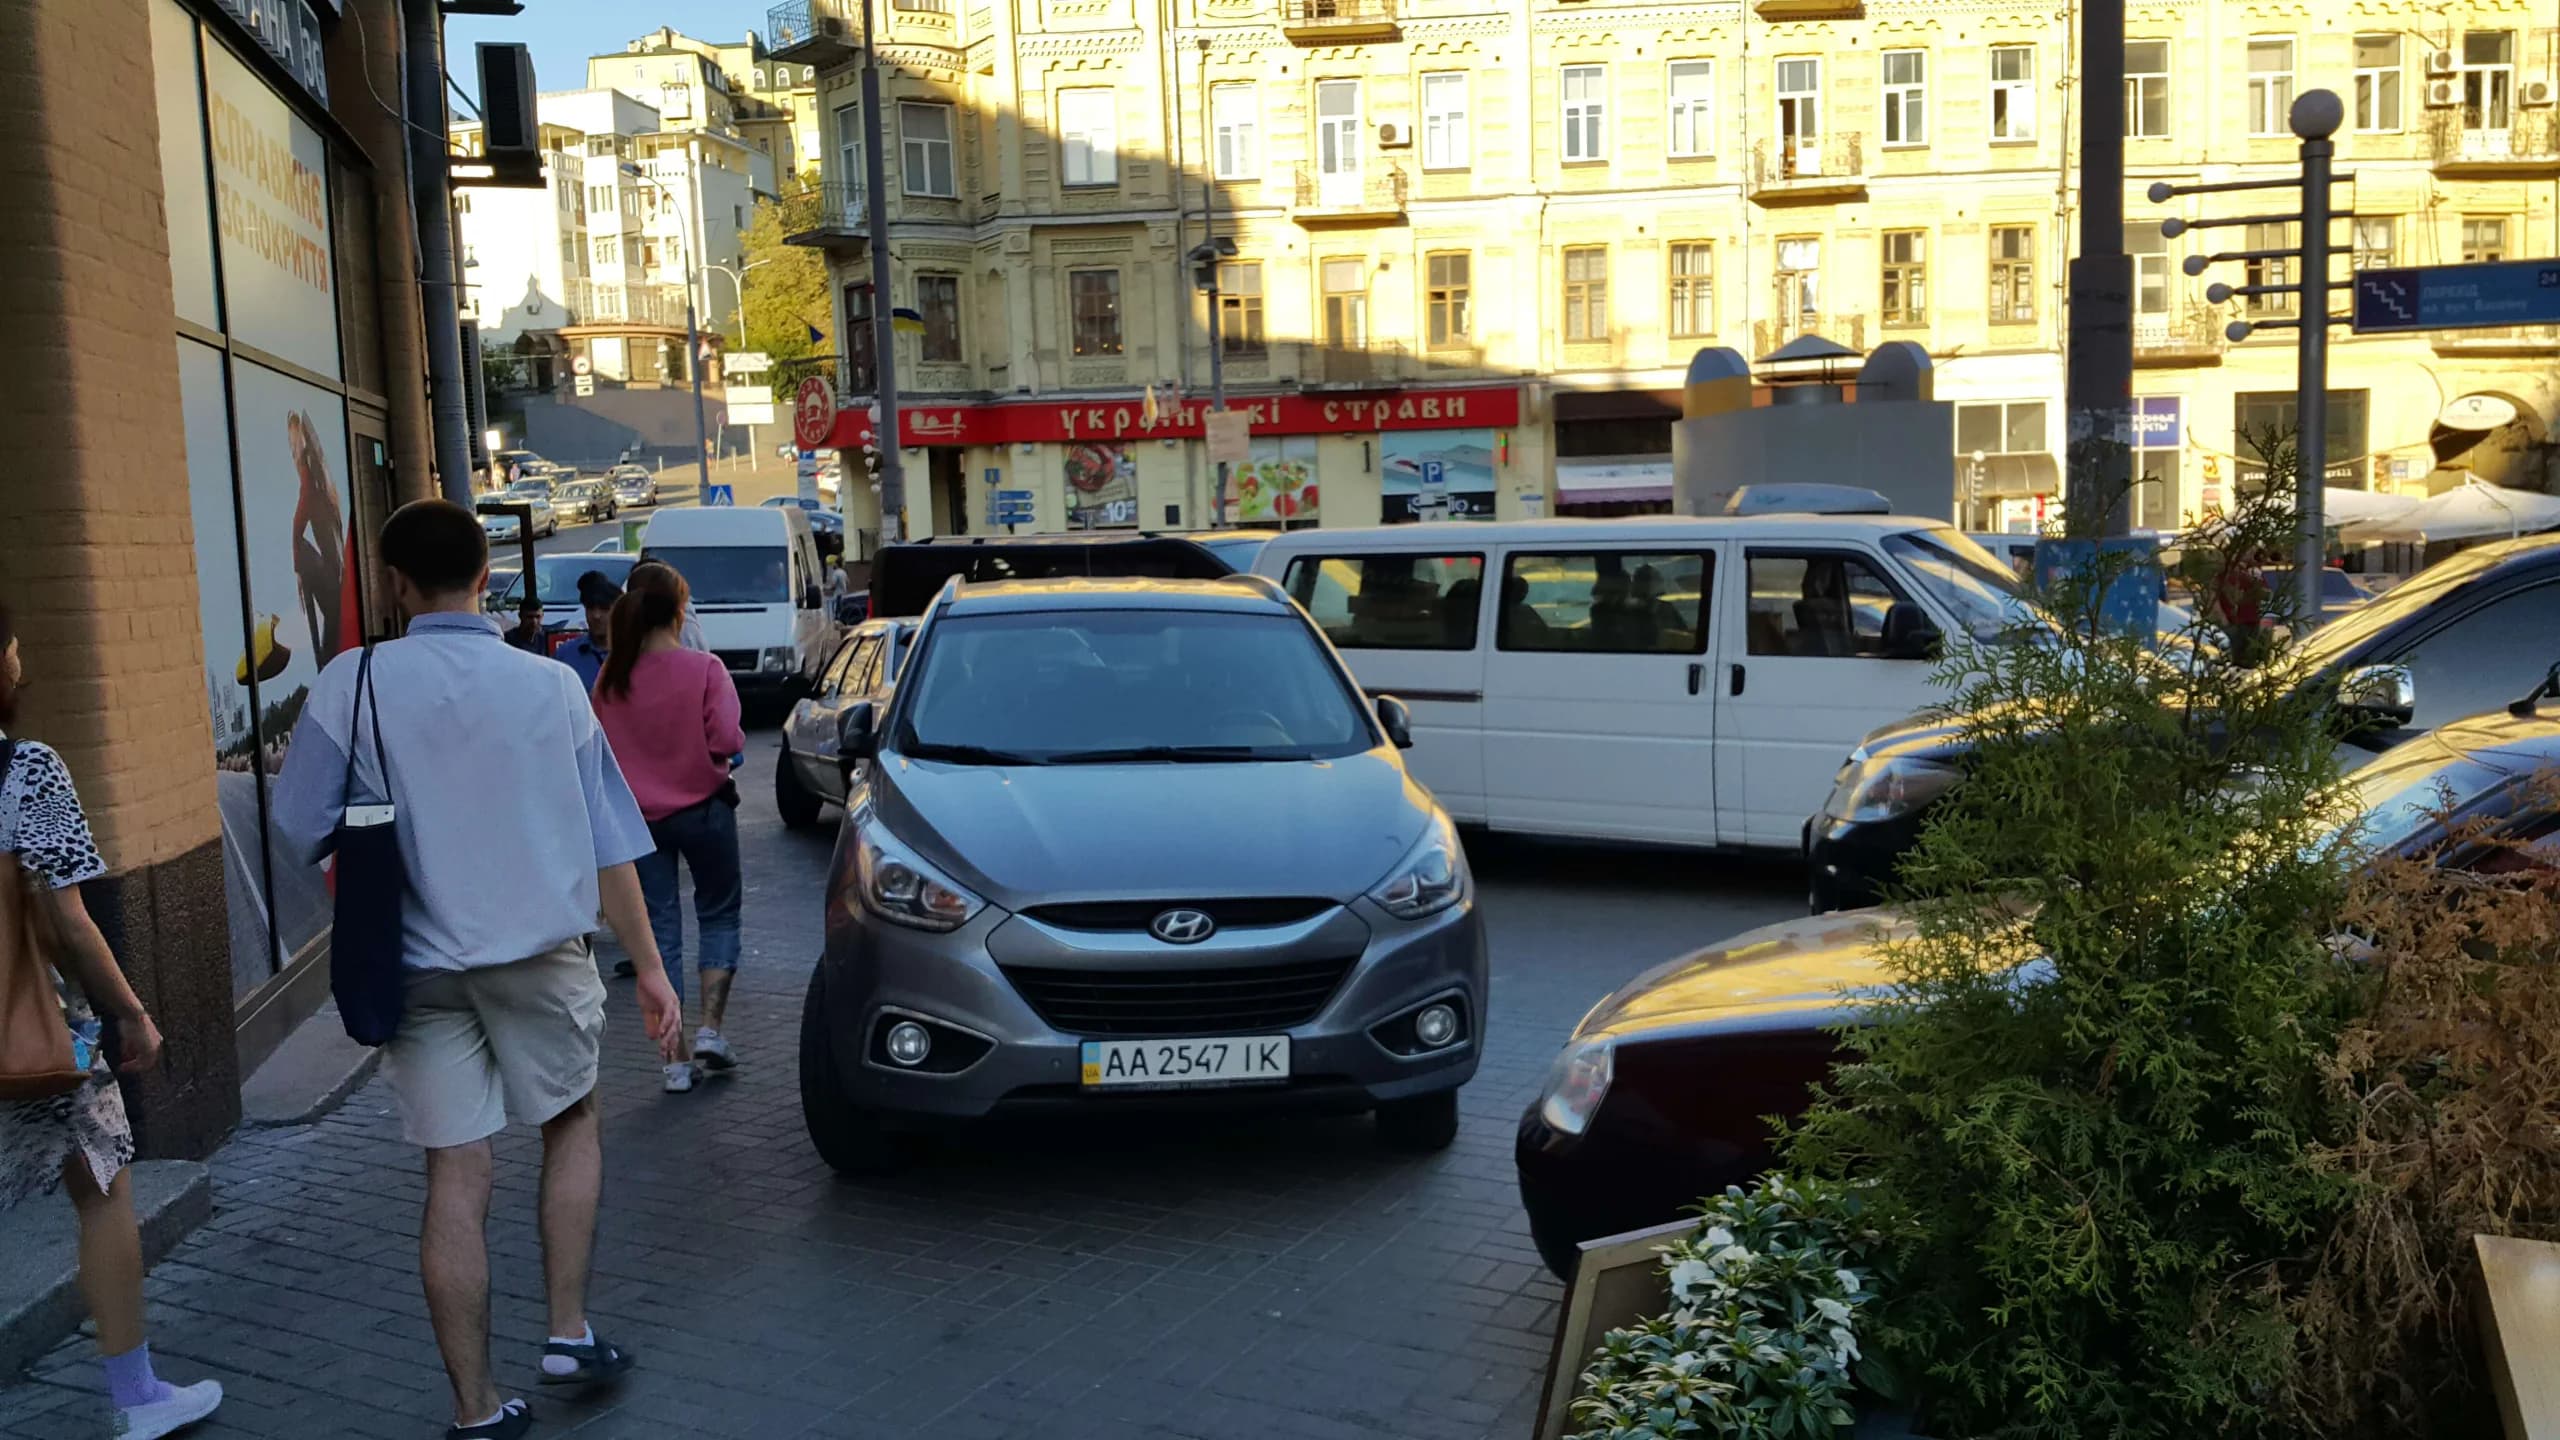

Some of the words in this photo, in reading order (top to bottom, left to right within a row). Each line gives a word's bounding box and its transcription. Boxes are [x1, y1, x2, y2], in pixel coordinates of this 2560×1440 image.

[1105, 1047, 1150, 1077] AA
[1157, 1043, 1229, 1076] 2547
[1245, 1041, 1281, 1072] IK
